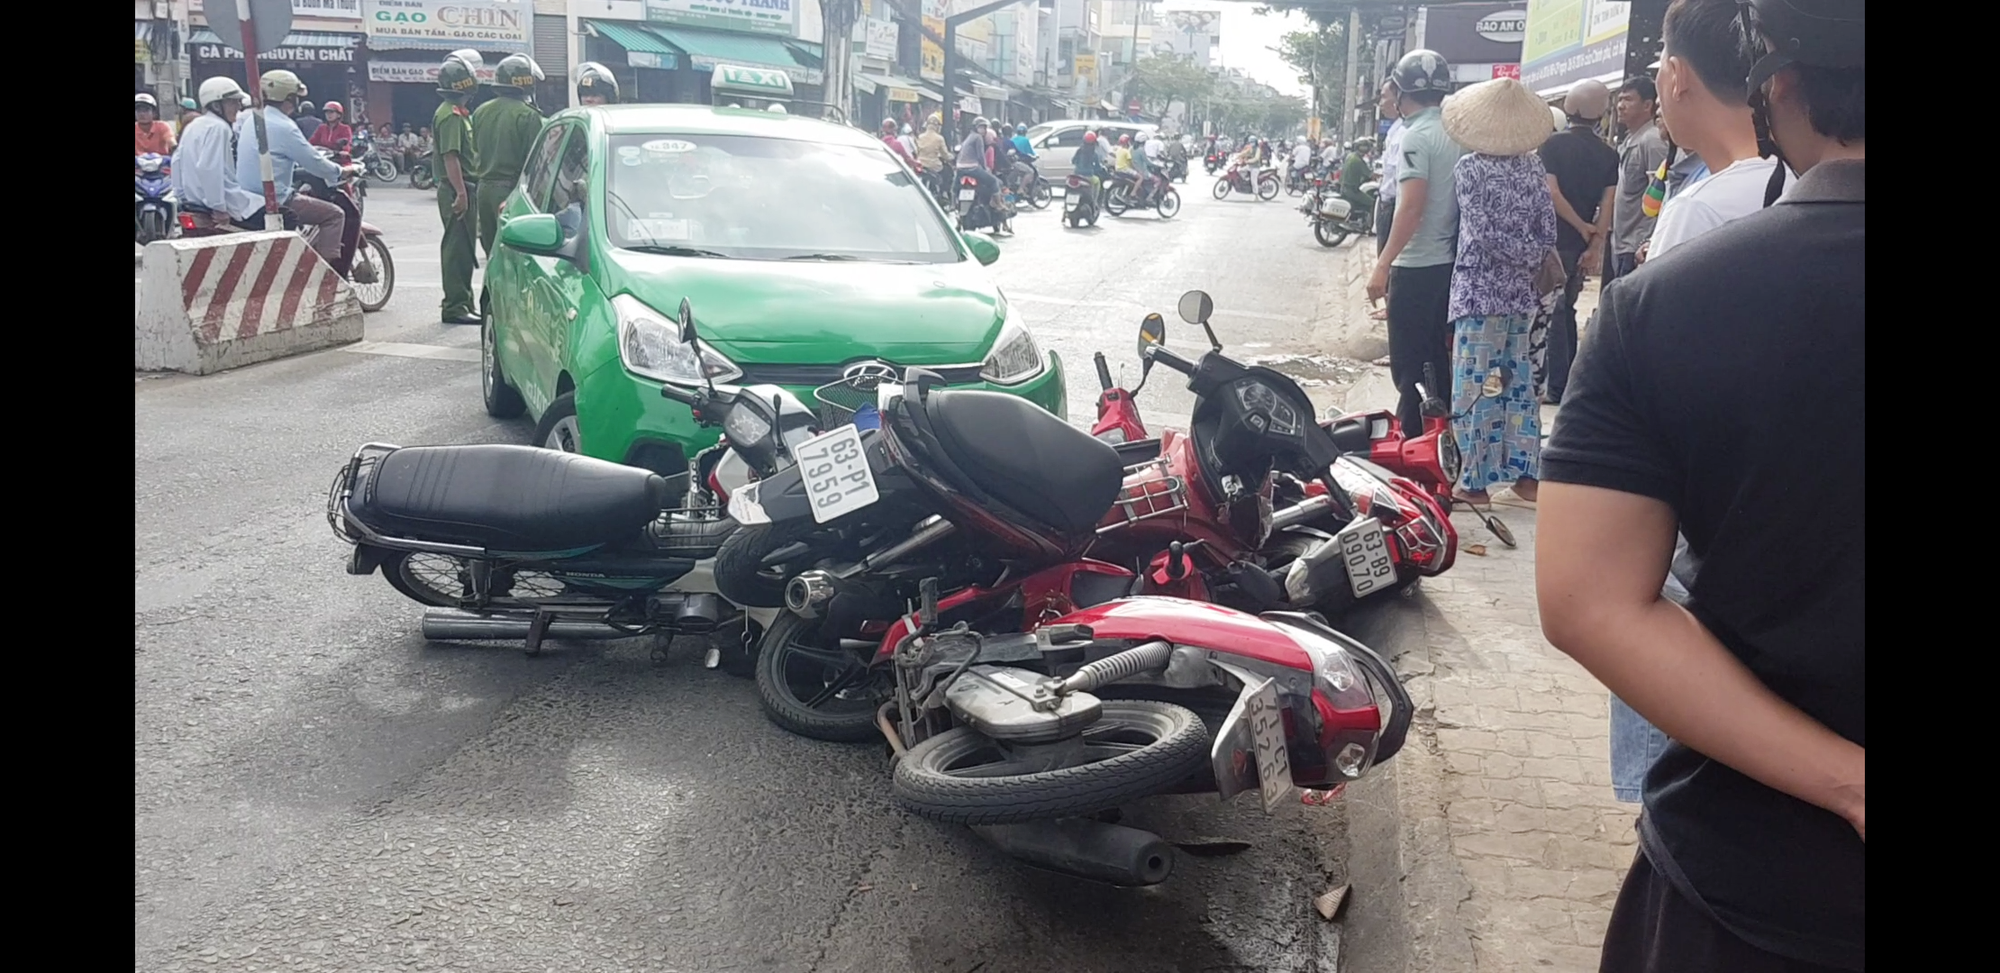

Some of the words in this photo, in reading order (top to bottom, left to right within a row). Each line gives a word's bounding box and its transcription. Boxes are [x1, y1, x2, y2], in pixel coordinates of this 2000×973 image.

[375, 10, 427, 25] GẠO
[375, 27, 398, 35] MUA
[437, 3, 521, 31] CHÍN
[1499, 21, 1515, 31] AN
[200, 45, 221, 59] CÀ
[318, 46, 354, 62] CHẤT
[725, 68, 785, 87] TAXI
[803, 447, 843, 509] 7959
[831, 437, 870, 496] 63-P1
[1342, 531, 1374, 592] 090.70
[1363, 530, 1391, 578] 63-B9
[1265, 697, 1288, 777] 71-C1
